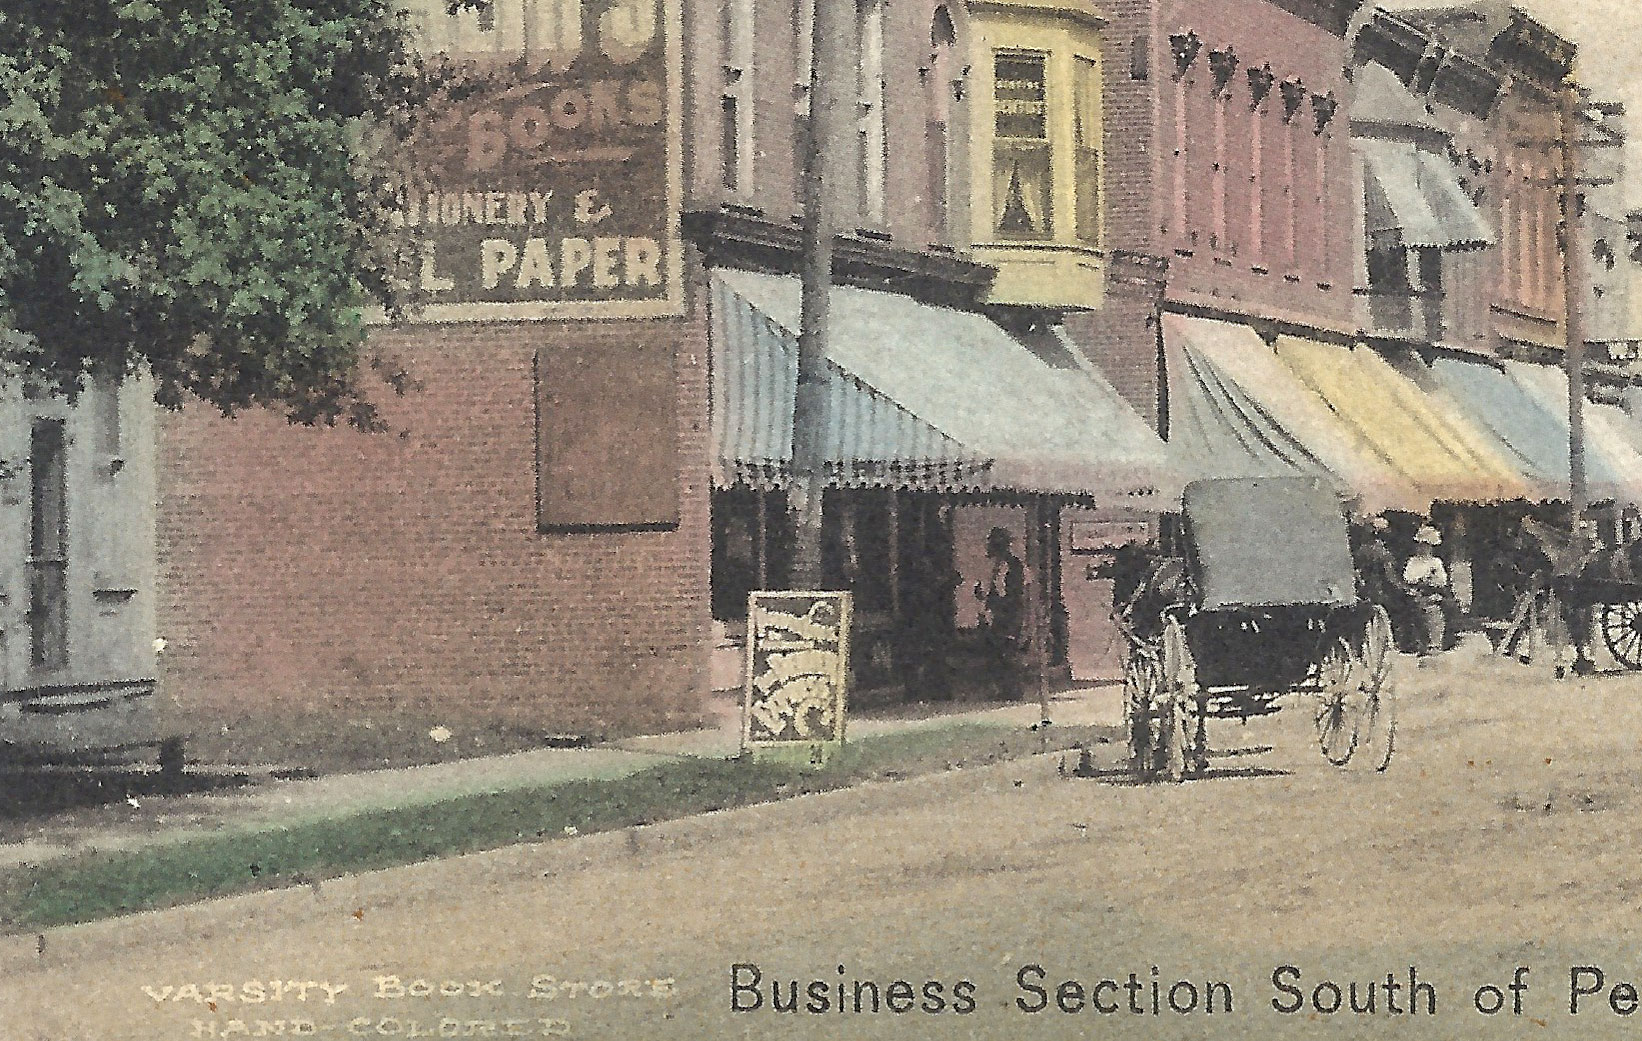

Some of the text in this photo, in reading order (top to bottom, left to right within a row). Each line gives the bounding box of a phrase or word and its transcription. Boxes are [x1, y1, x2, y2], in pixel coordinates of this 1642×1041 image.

[466, 78, 663, 171] BOOKS
[573, 189, 613, 223] &
[480, 237, 662, 289] PAPER
